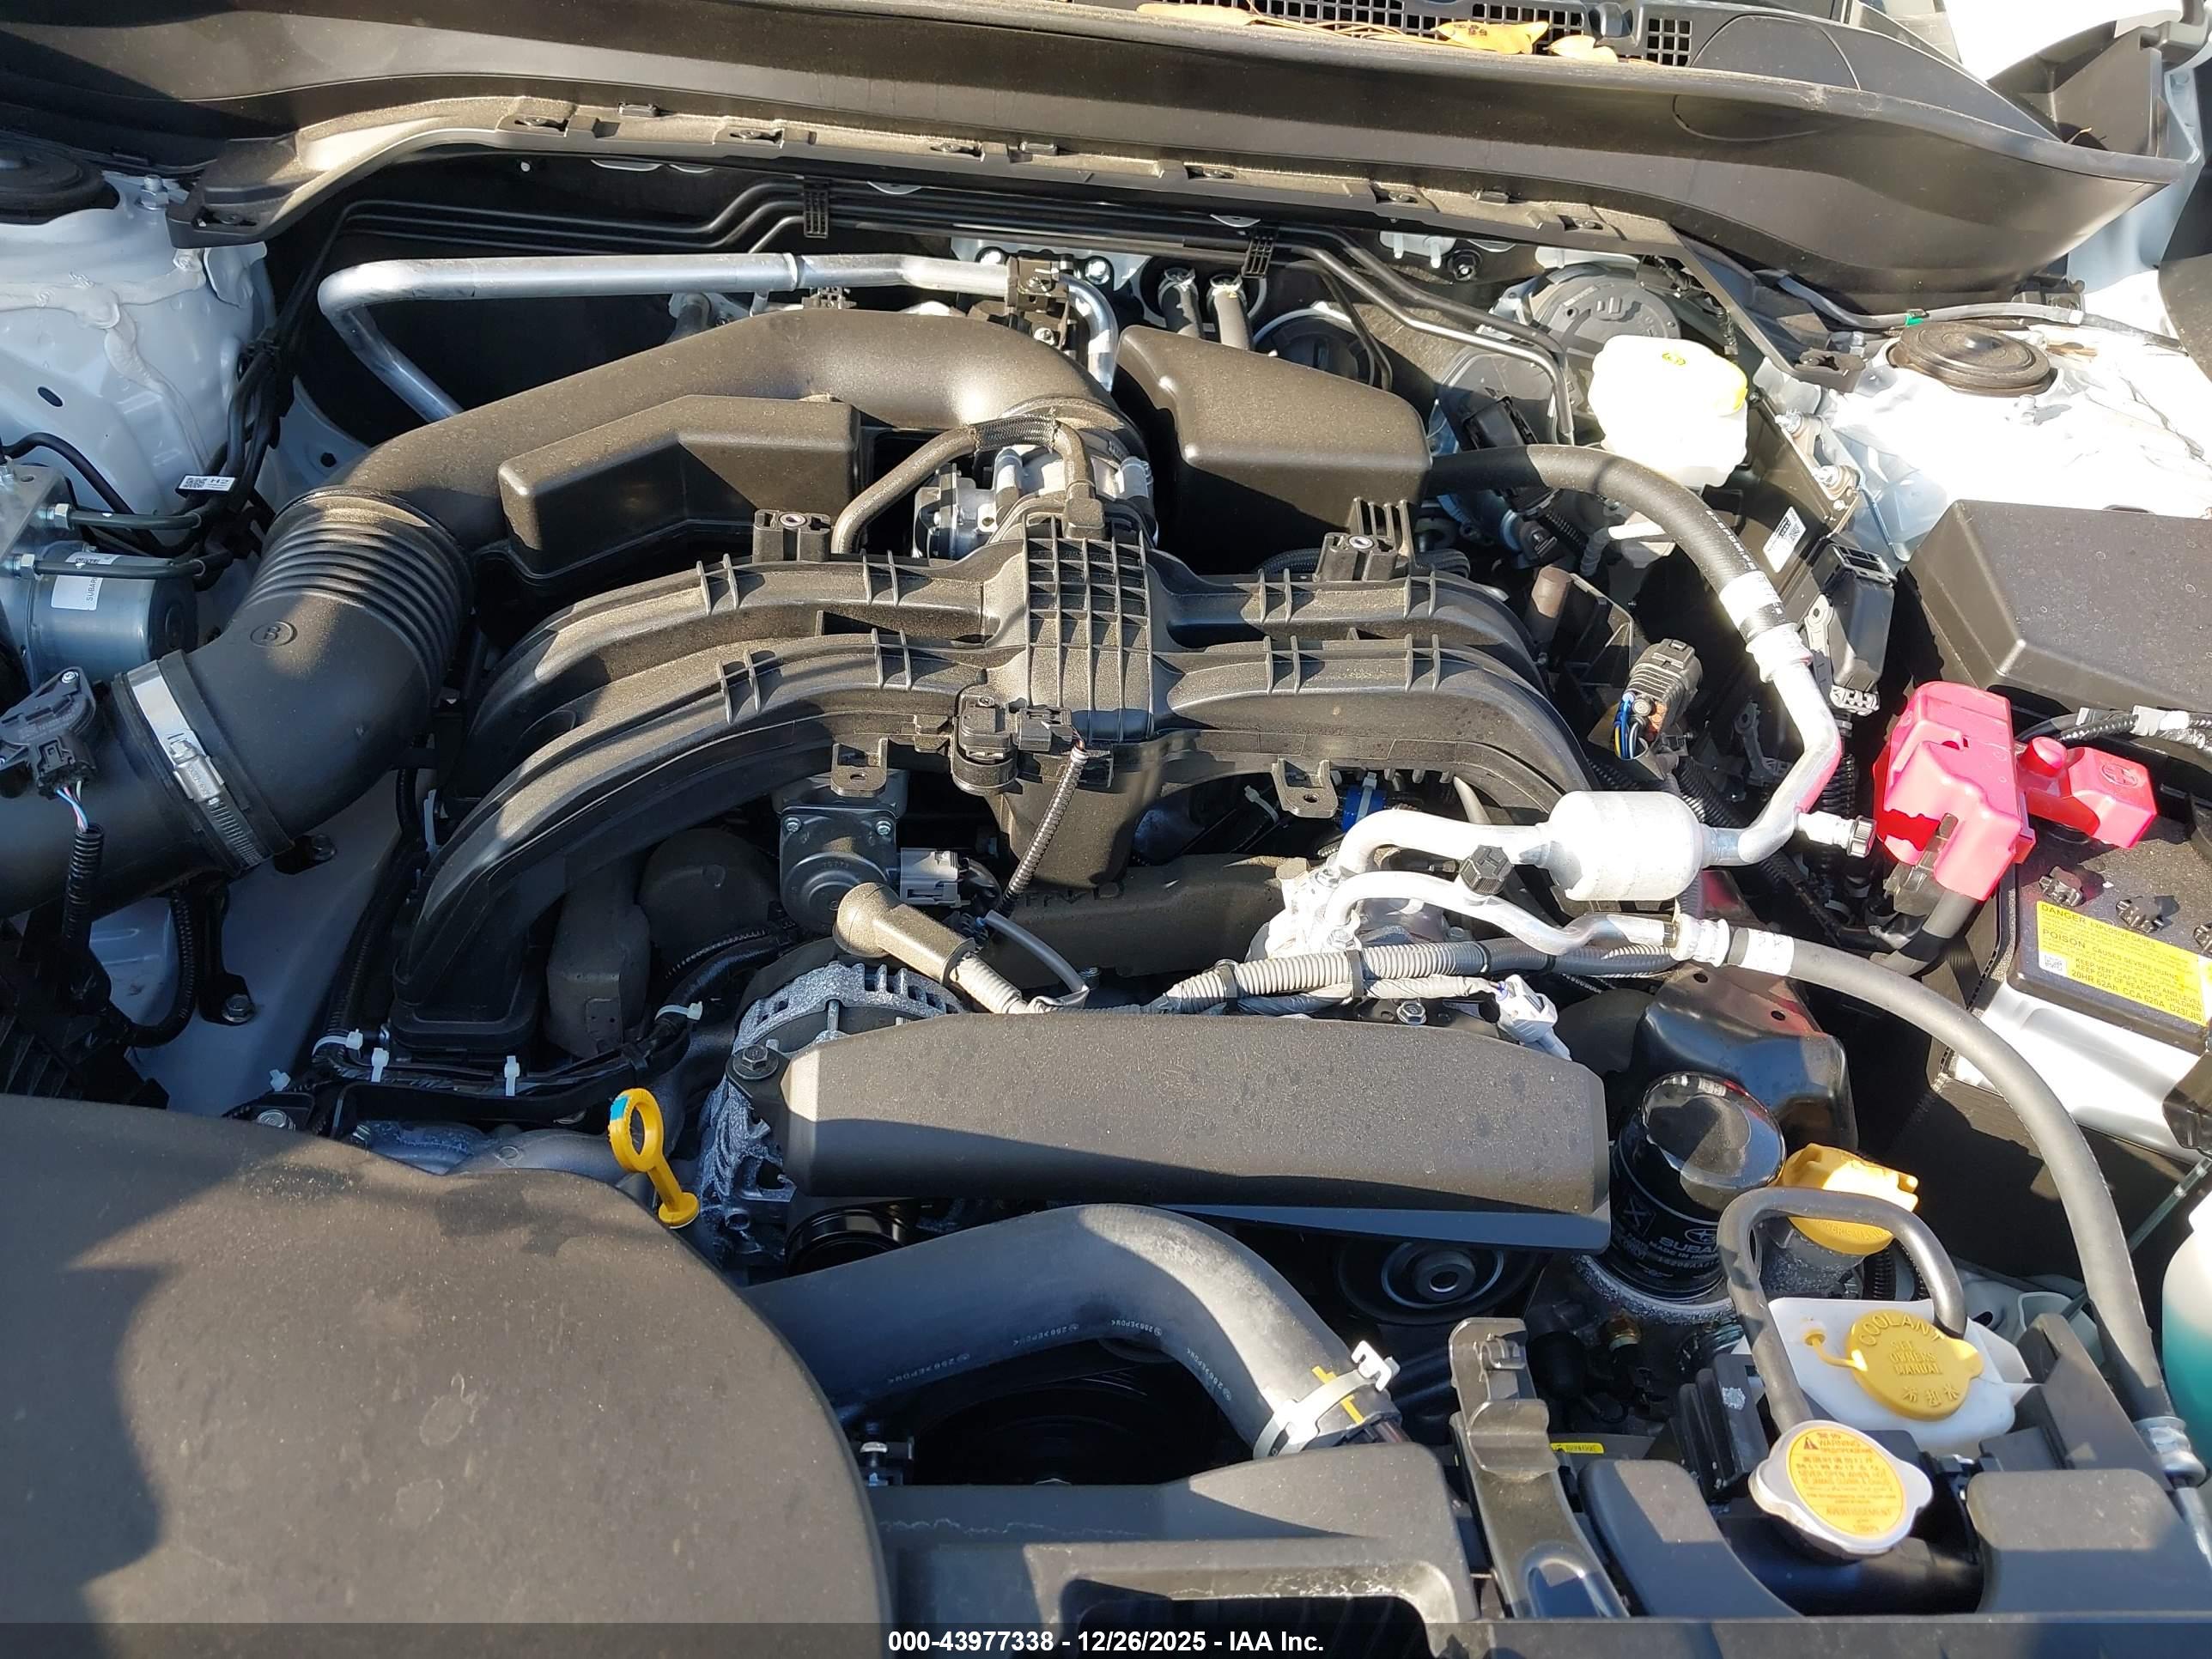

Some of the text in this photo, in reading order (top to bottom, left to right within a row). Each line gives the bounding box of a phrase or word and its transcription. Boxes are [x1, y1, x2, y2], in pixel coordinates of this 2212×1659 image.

[261, 626, 281, 642] B
[2041, 904, 2156, 949] DANGER EXPLOSIVE GASES
[2042, 928, 2179, 980] POISON CAUSES SEVERE BURNS
[2071, 969, 2095, 983] 20HR
[2122, 987, 2142, 1000] CCA
[2075, 957, 2202, 1006] KEEP VENT CAPS TIGHT AND LEVEL
[2075, 963, 2095, 975] KEEP
[2097, 969, 2113, 981] OUT
[2126, 980, 2152, 994] REACH
[2153, 988, 2164, 997] OF
[2164, 993, 2203, 1012] CHILDREN
[1658, 1236, 1719, 1255] SUBA
[1858, 1312, 1945, 1346] COOLANT
[1890, 1340, 1916, 1351] SEE
[1893, 1362, 1942, 1376] MANUAL
